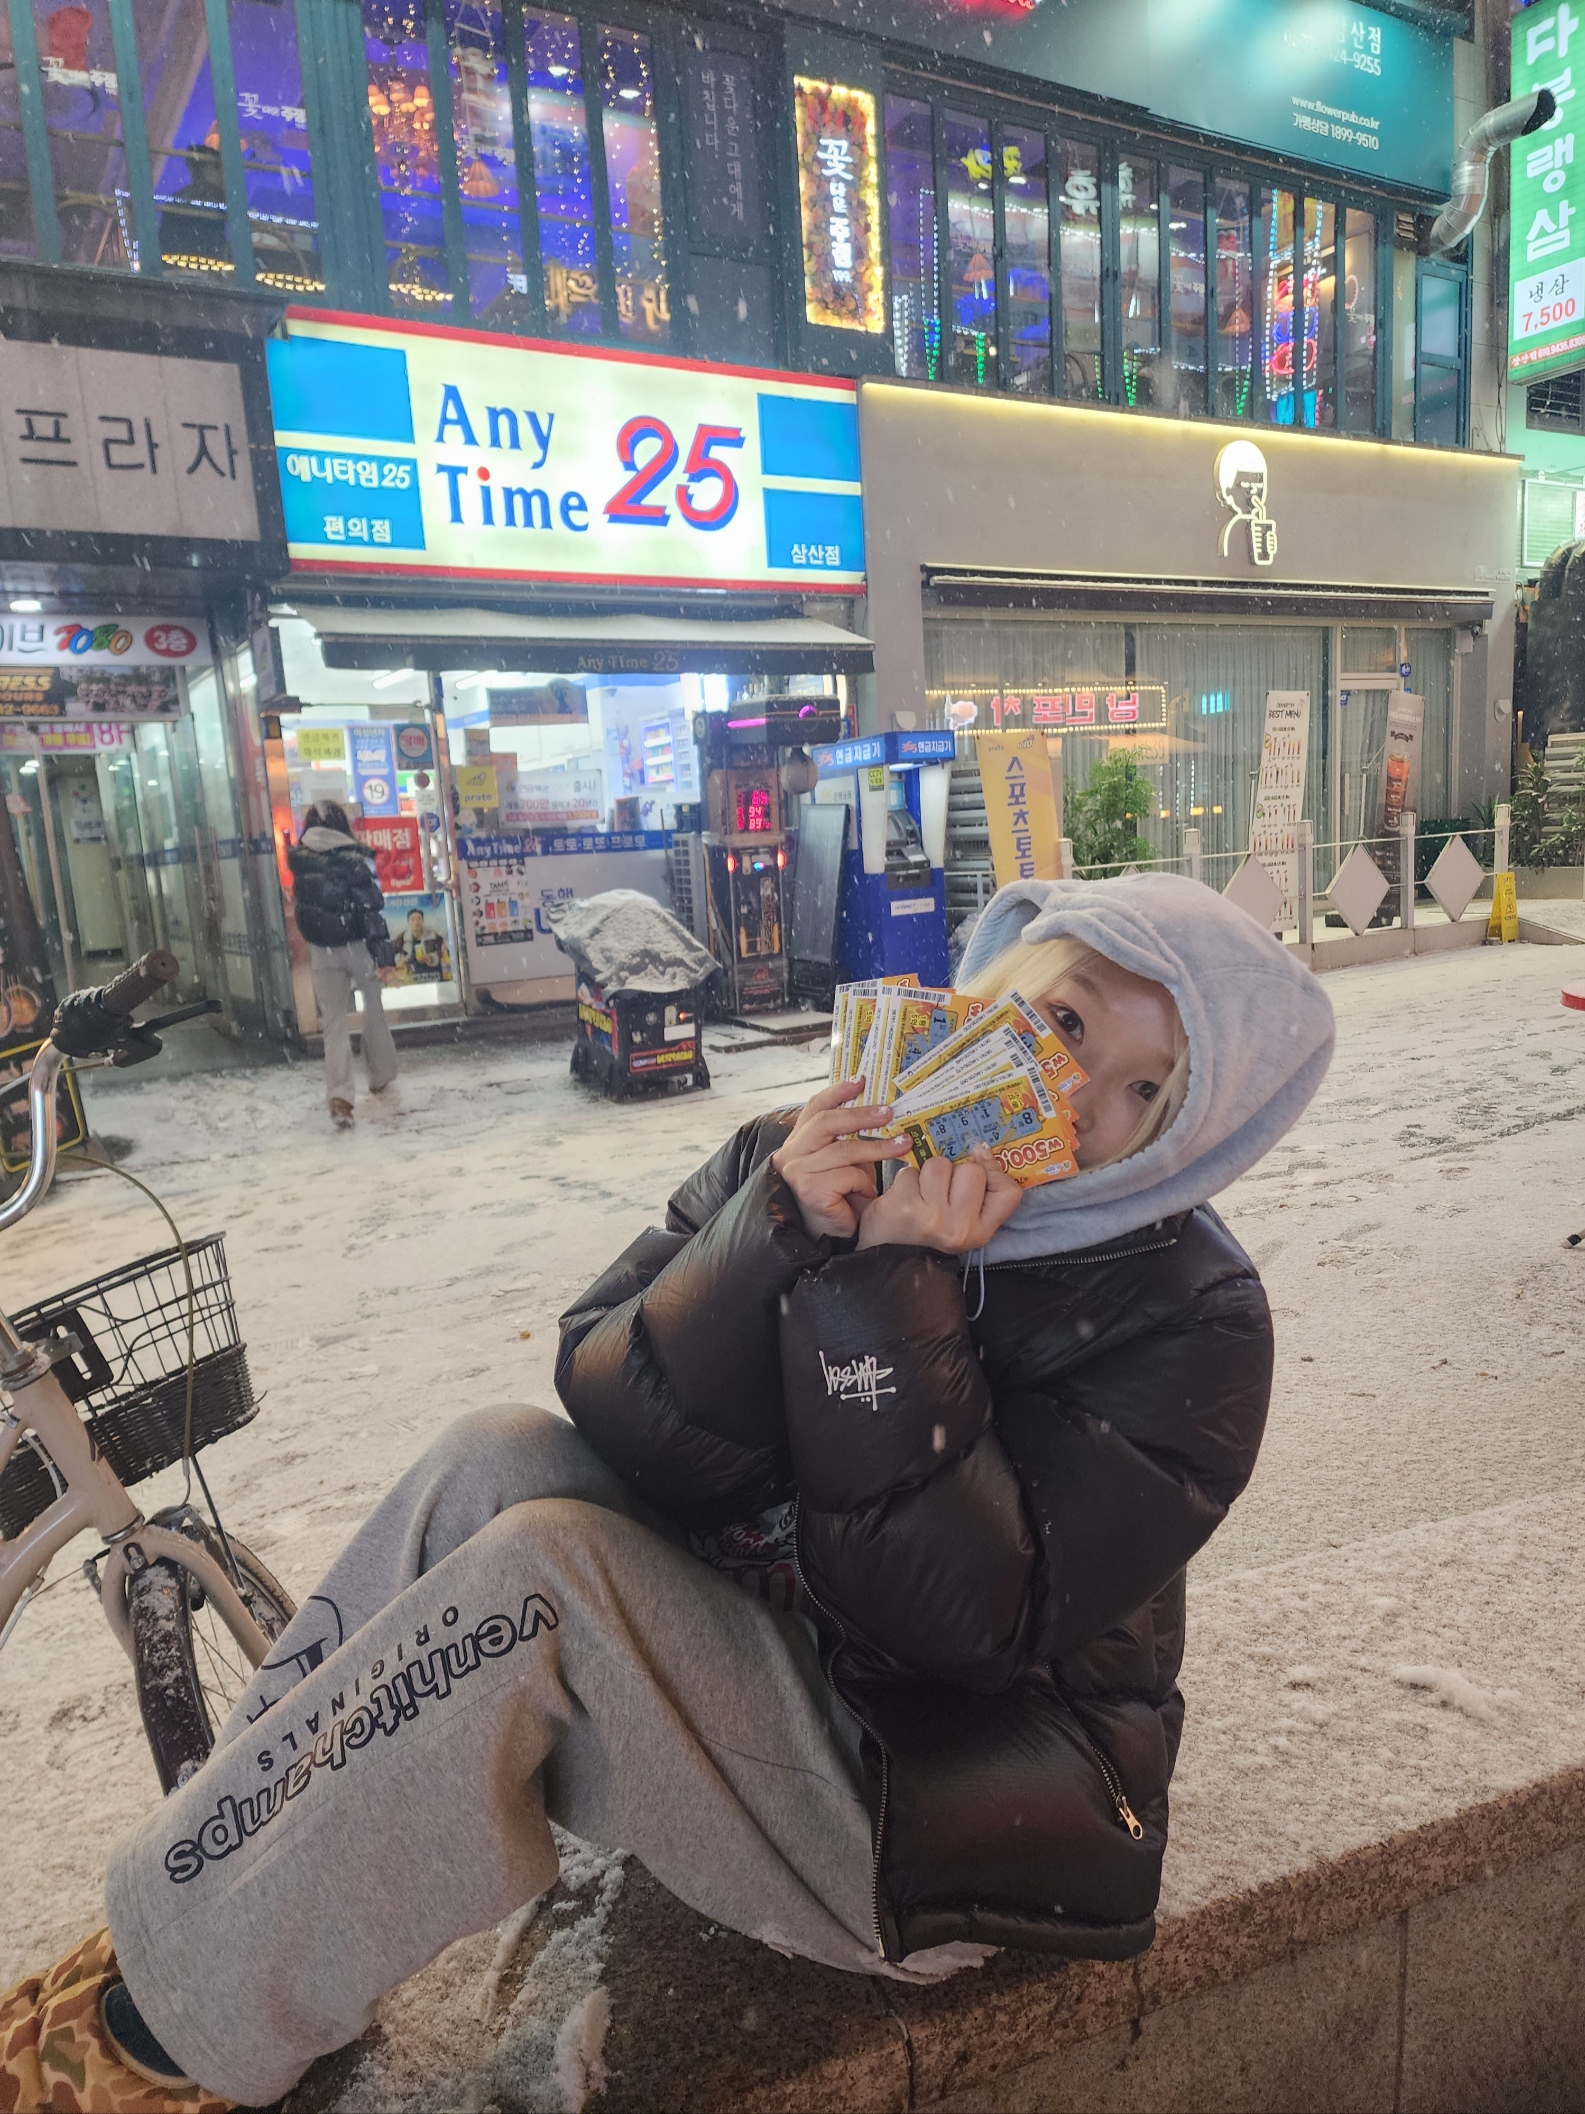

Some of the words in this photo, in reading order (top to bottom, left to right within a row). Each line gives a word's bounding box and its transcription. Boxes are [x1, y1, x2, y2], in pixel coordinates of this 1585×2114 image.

[1290, 95, 1380, 130] www.flowerpub.co.kr
[1330, 123, 1379, 151] 1899-9510
[1522, 298, 1576, 332] 7,500
[435, 384, 555, 470] Any
[14, 408, 239, 481] 프라자
[286, 453, 379, 489] 애니타임
[381, 465, 412, 490] 25
[435, 464, 590, 533] Time
[603, 415, 747, 532] 25
[324, 515, 392, 545] 편의점
[790, 542, 841, 568] 삼산점
[52, 623, 134, 656] 7080
[577, 656, 604, 671] Any
[608, 655, 648, 669] Time
[653, 652, 680, 672] 25
[1268, 710, 1284, 719] BEST
[835, 741, 881, 765] 현금지급기
[917, 740, 952, 753] 현금지급기
[869, 769, 883, 778] CCTV
[367, 783, 385, 800] 19
[464, 795, 492, 803] proto
[257, 1606, 460, 1772] ORIGINALS
[164, 1593, 560, 1885] venhitchamps
